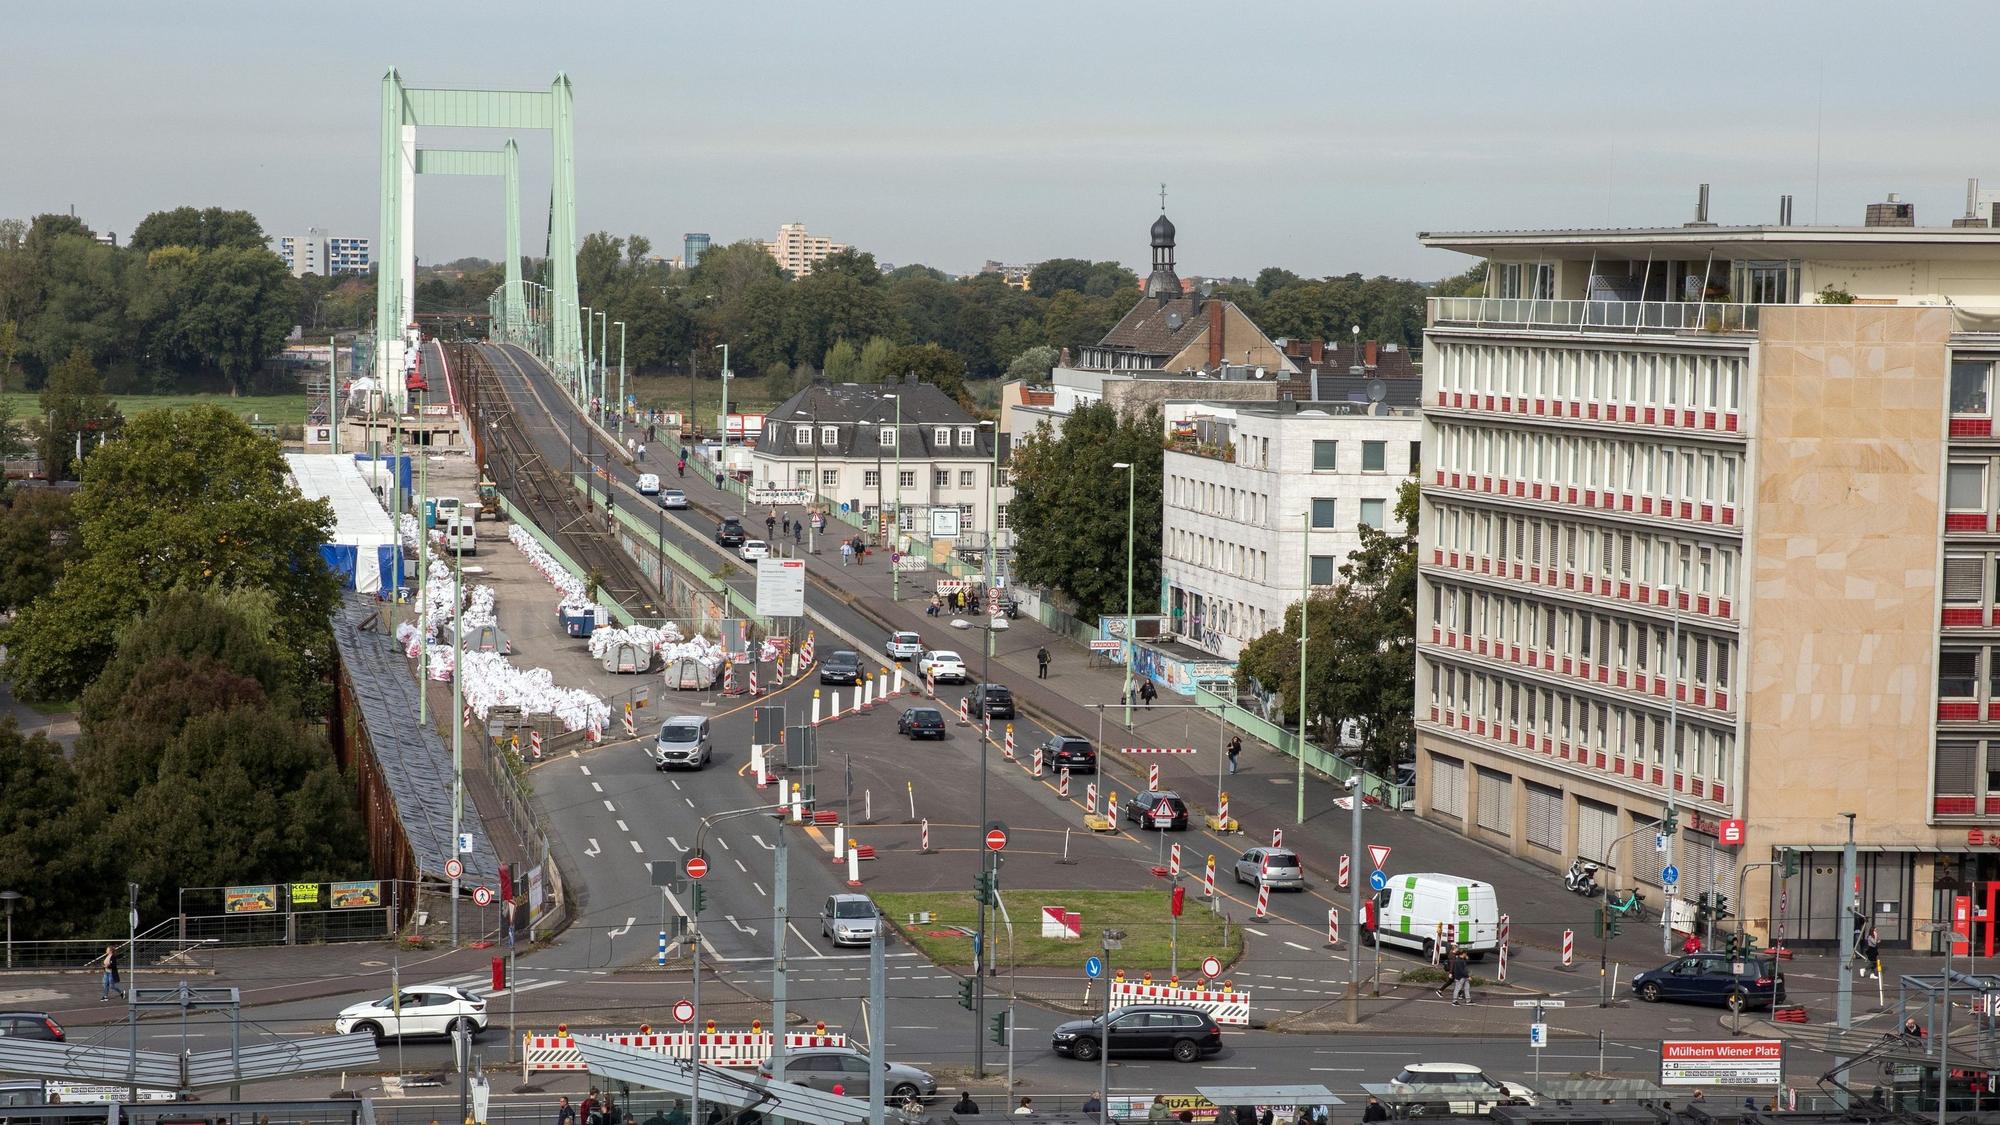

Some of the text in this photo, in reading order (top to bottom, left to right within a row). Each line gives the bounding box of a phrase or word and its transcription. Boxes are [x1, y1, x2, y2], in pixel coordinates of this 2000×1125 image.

[1669, 1047, 1779, 1056] Mülheim Wiener Platz
